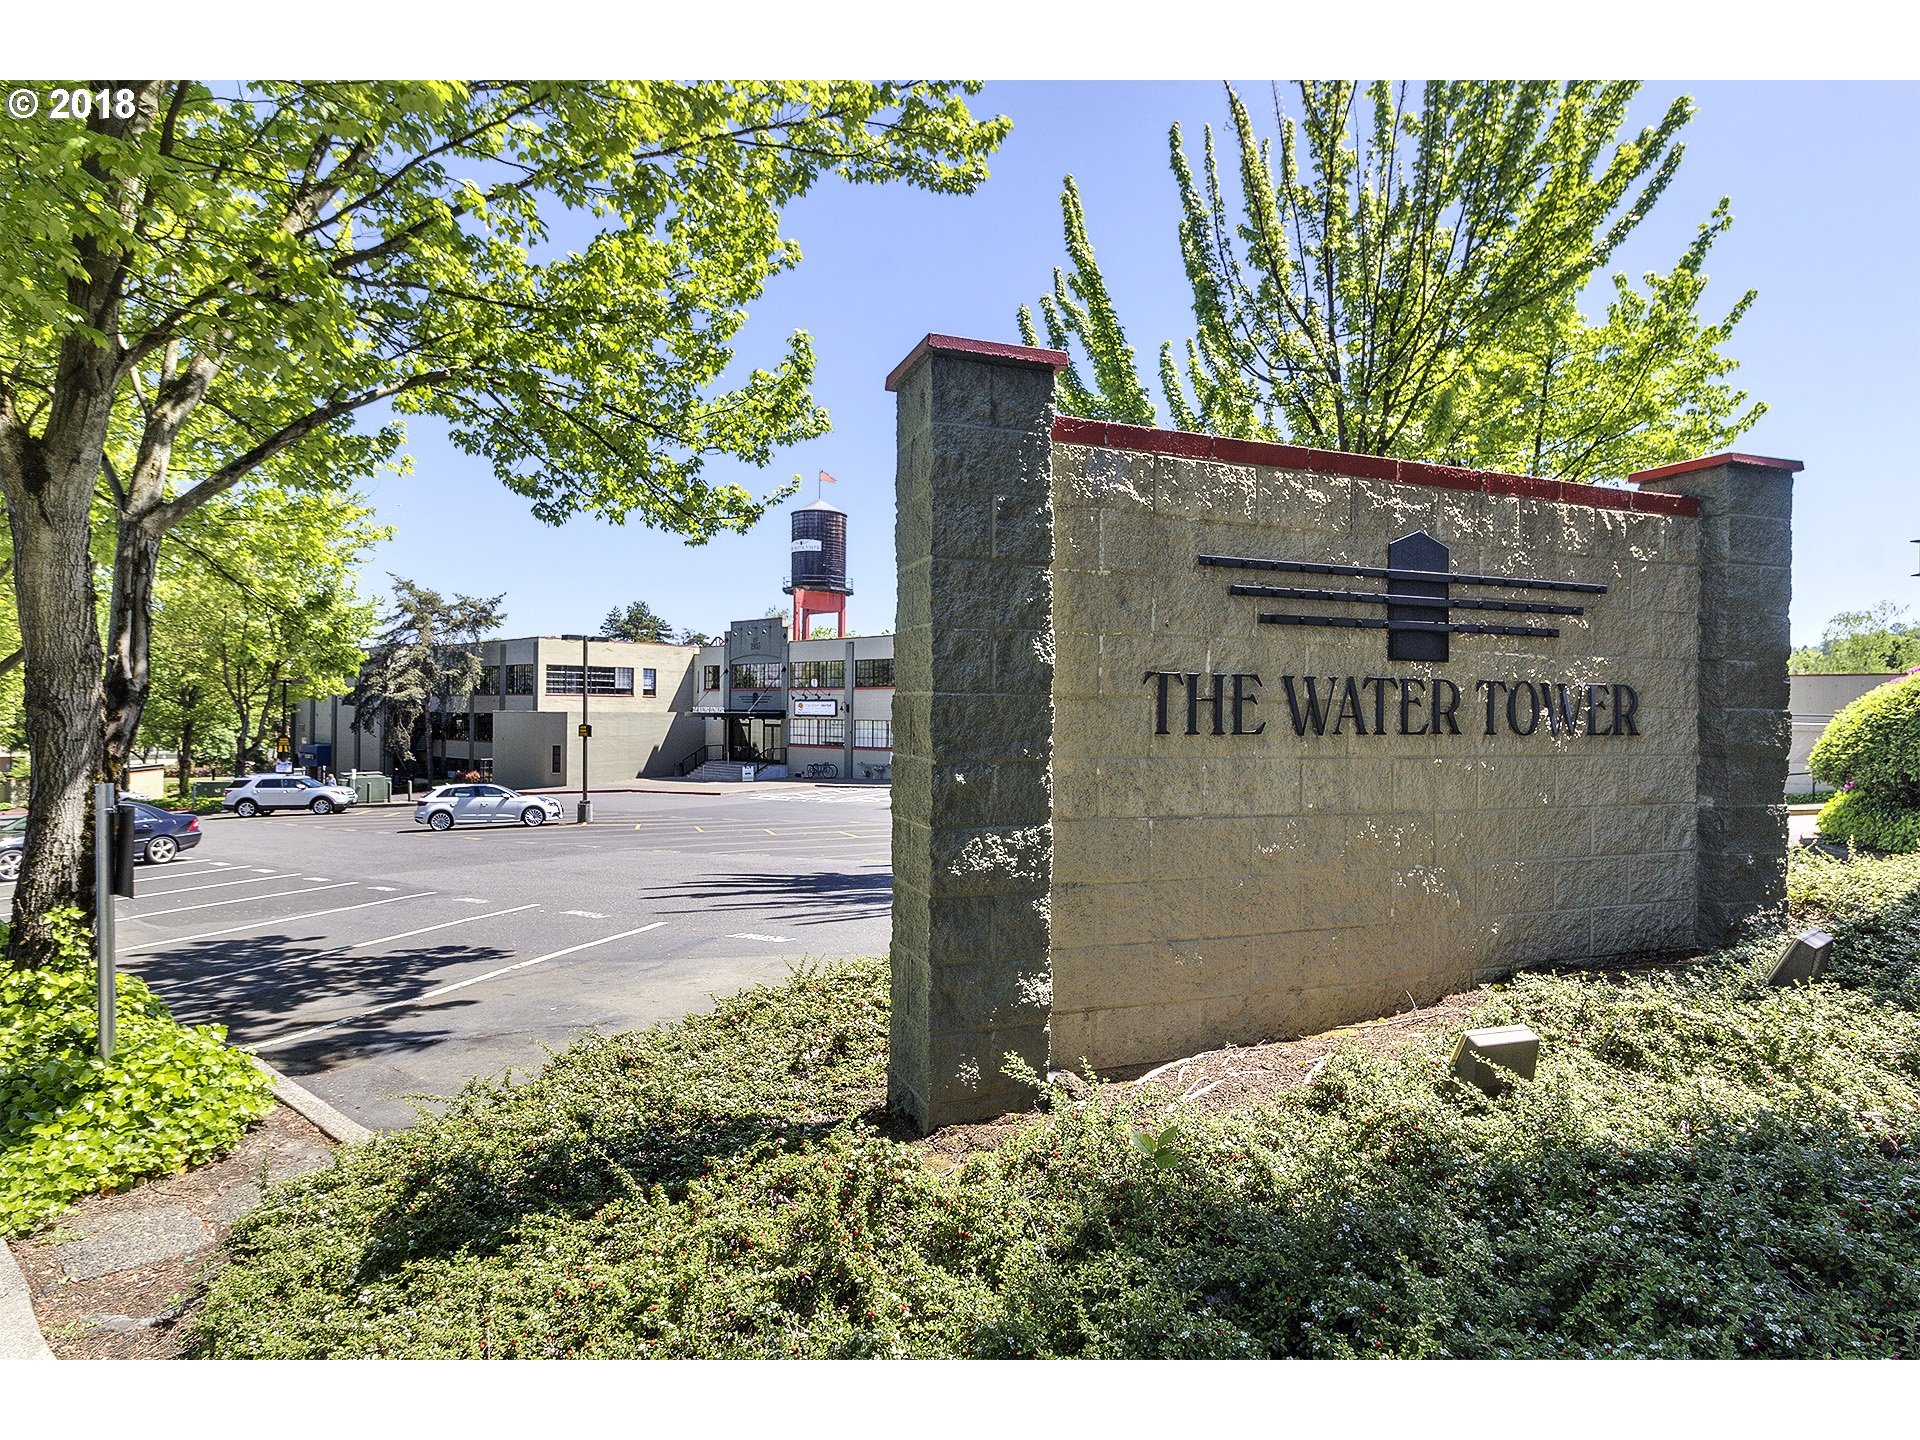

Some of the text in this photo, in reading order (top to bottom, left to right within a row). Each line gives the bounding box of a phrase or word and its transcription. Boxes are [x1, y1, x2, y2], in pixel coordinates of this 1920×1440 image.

[1142, 670, 1641, 736] THE WATER TOWER
